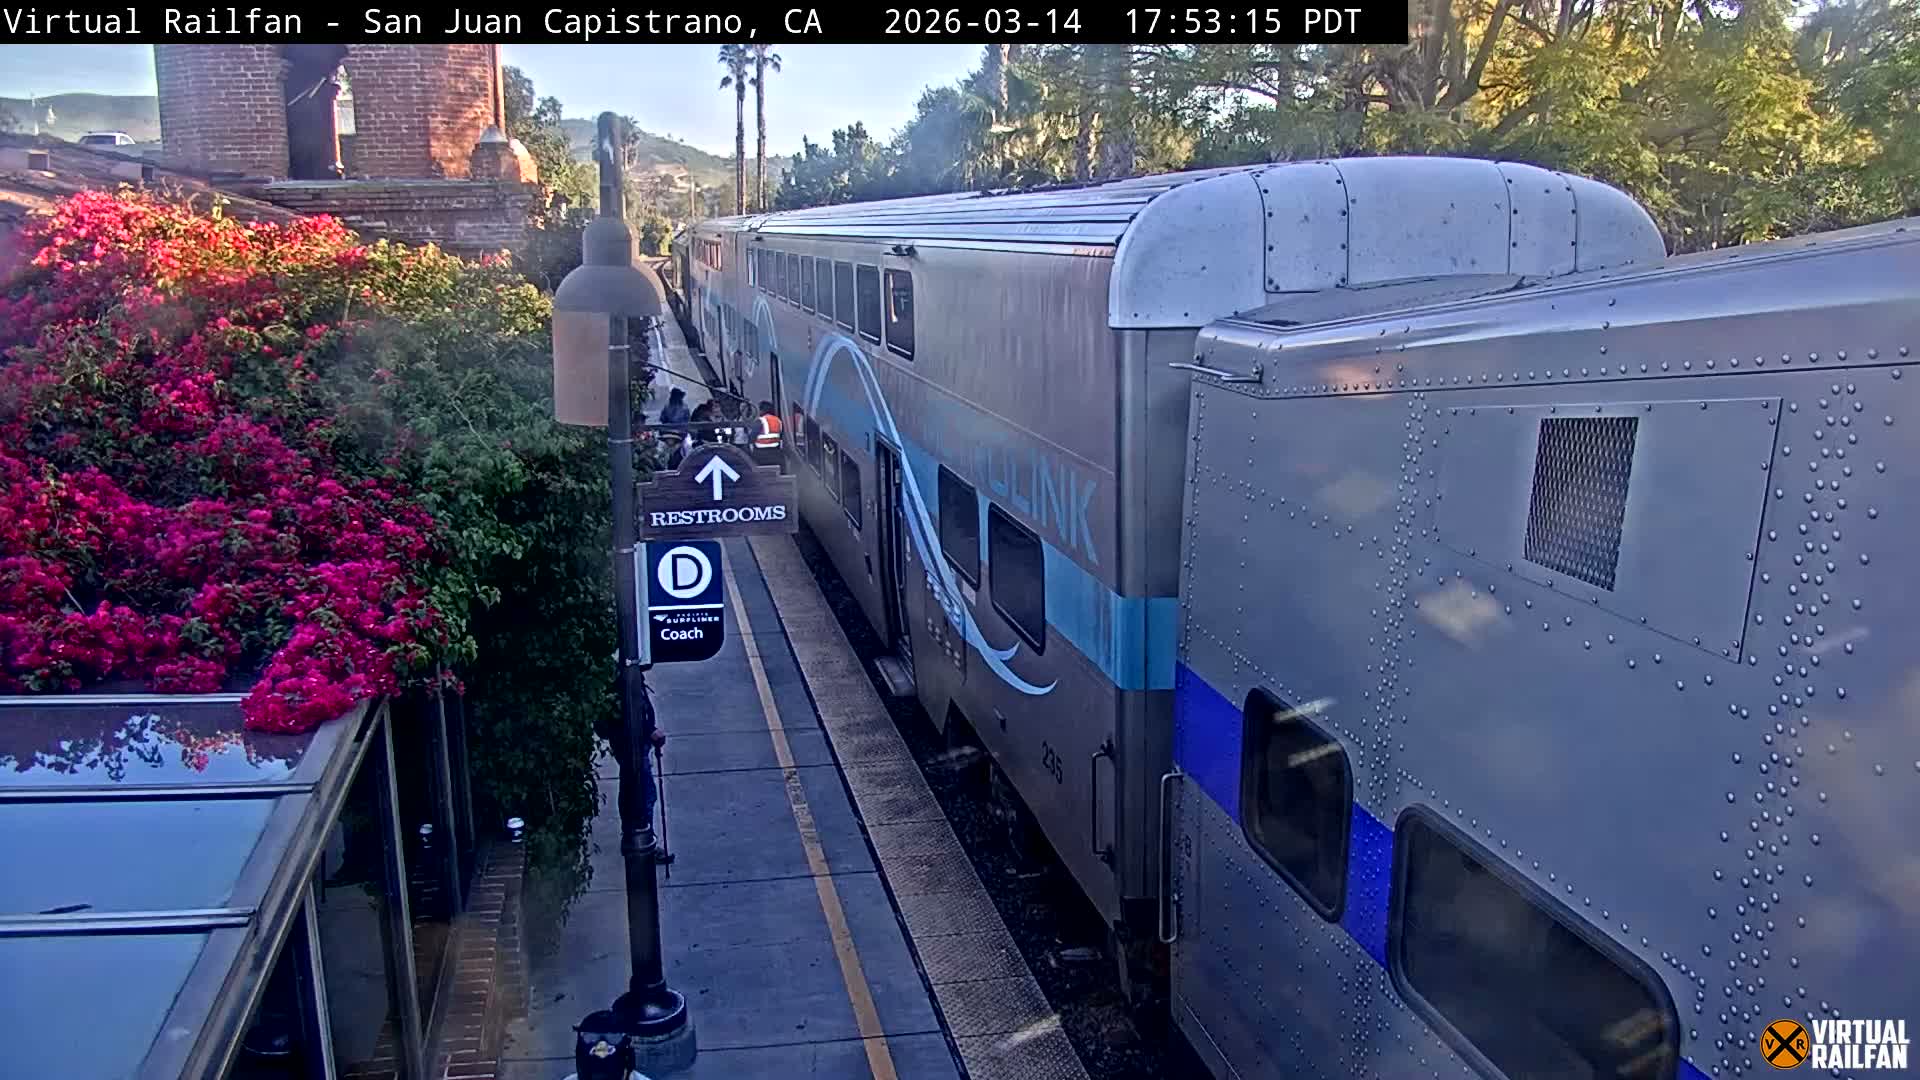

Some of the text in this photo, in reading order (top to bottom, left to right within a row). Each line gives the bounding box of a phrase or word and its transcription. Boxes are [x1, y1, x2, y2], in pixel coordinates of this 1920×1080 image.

[651, 505, 786, 527] RESTROOMS
[671, 553, 703, 591] D
[666, 616, 720, 624] SURFLINER
[660, 627, 704, 640] Coach
[1041, 740, 1063, 785] 235
